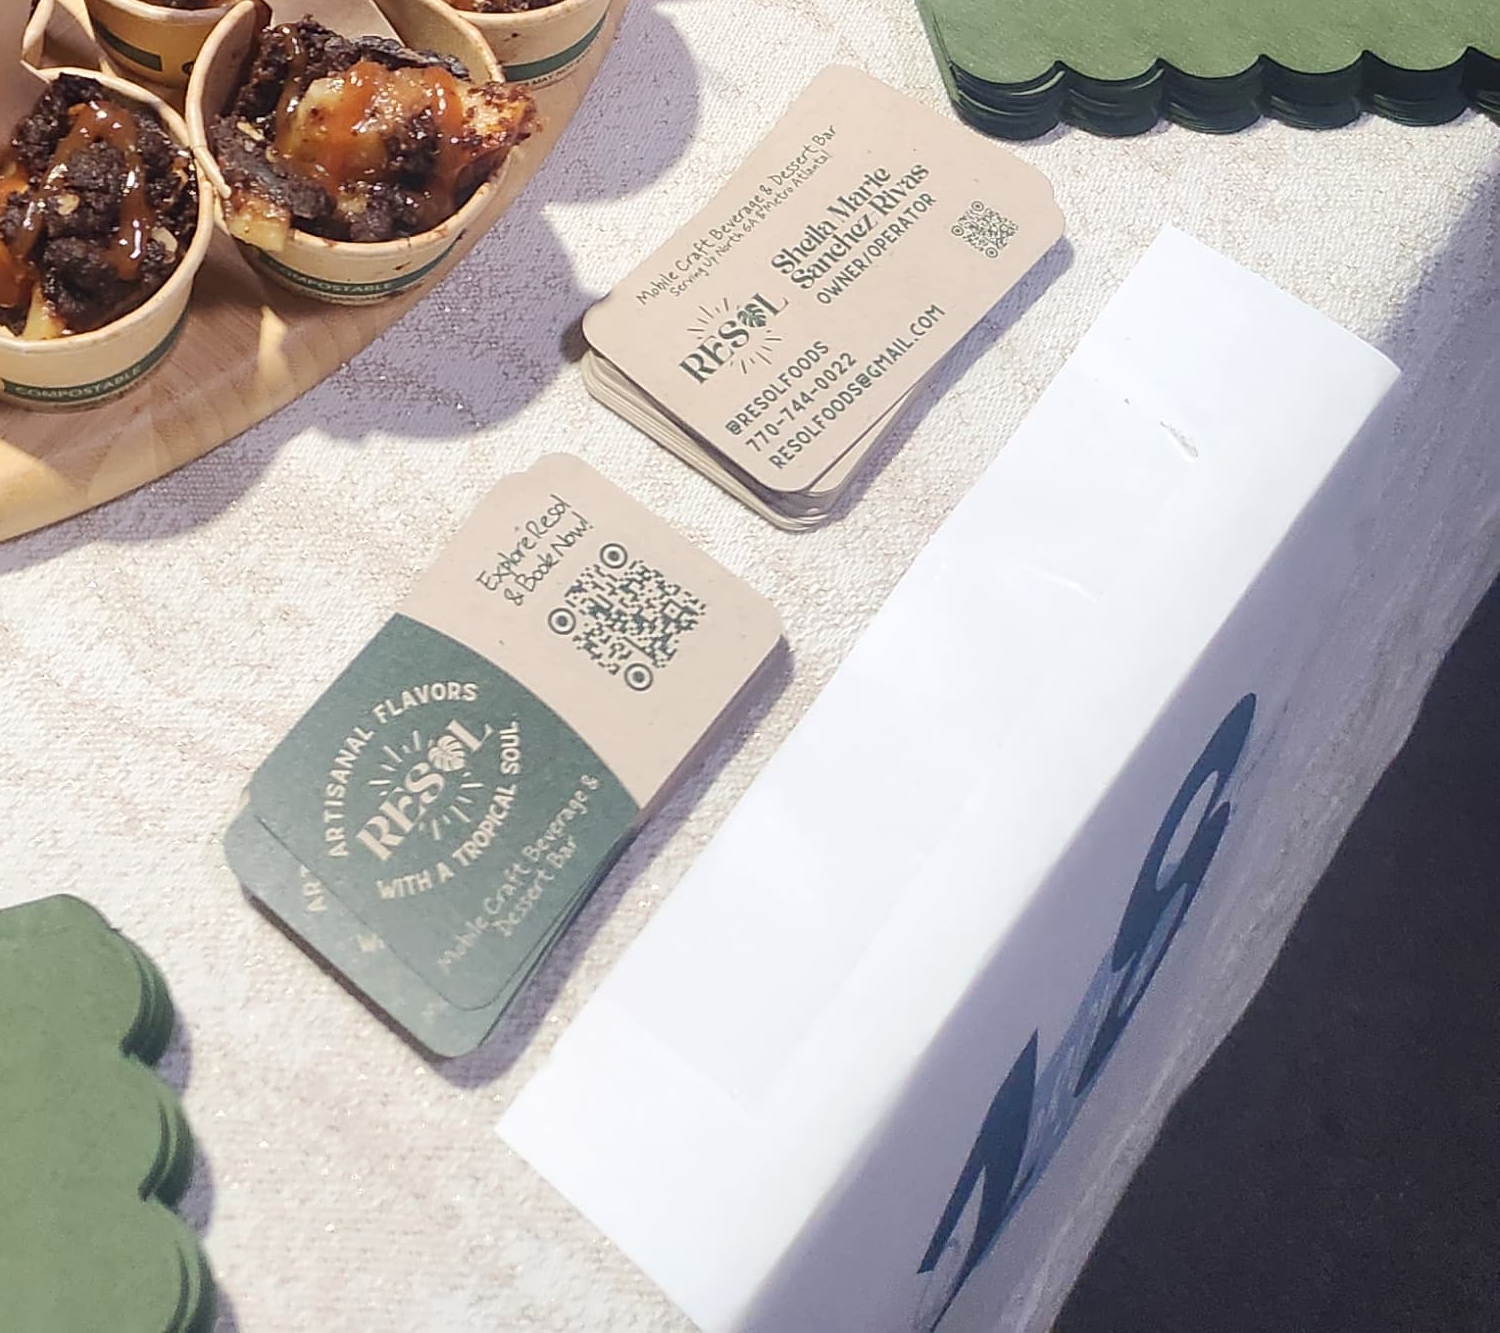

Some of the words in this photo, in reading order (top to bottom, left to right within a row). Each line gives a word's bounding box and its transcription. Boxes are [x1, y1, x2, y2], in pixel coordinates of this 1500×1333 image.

[636, 270, 679, 306] Mobile
[675, 238, 715, 272] Craft
[710, 194, 765, 241] Beverage
[759, 184, 773, 196] &
[767, 145, 819, 186] Dessert
[812, 124, 837, 147] Bar
[670, 265, 710, 297] Serving
[715, 232, 744, 257] North
[762, 186, 794, 213] Metro
[771, 220, 838, 274] Sheila
[826, 167, 891, 223] Marie
[790, 213, 879, 289] Sanchez
[868, 164, 930, 216] Rivas
[816, 193, 937, 304] OWNER/OPERATOR
[14, 364, 142, 398] COMPOSTABLE
[725, 340, 829, 436] @RESOLFOODS
[746, 351, 857, 453] 770-744-0022
[768, 304, 946, 470] RESOLFOODS@GMAIL.COM
[476, 537, 537, 590] Explore
[525, 494, 571, 539] Resol
[503, 587, 524, 606] &
[514, 553, 560, 592] Book
[550, 511, 593, 557] Now!
[323, 726, 374, 857] ARTISANAL
[372, 681, 479, 724] FLAVORS
[376, 869, 433, 900] WITH
[435, 861, 456, 884] A
[452, 784, 517, 867] TROPICAL
[500, 720, 521, 775] SOUL
[484, 863, 531, 915] Craft
[522, 789, 589, 862] Beverage
[546, 834, 576, 868] Bar
